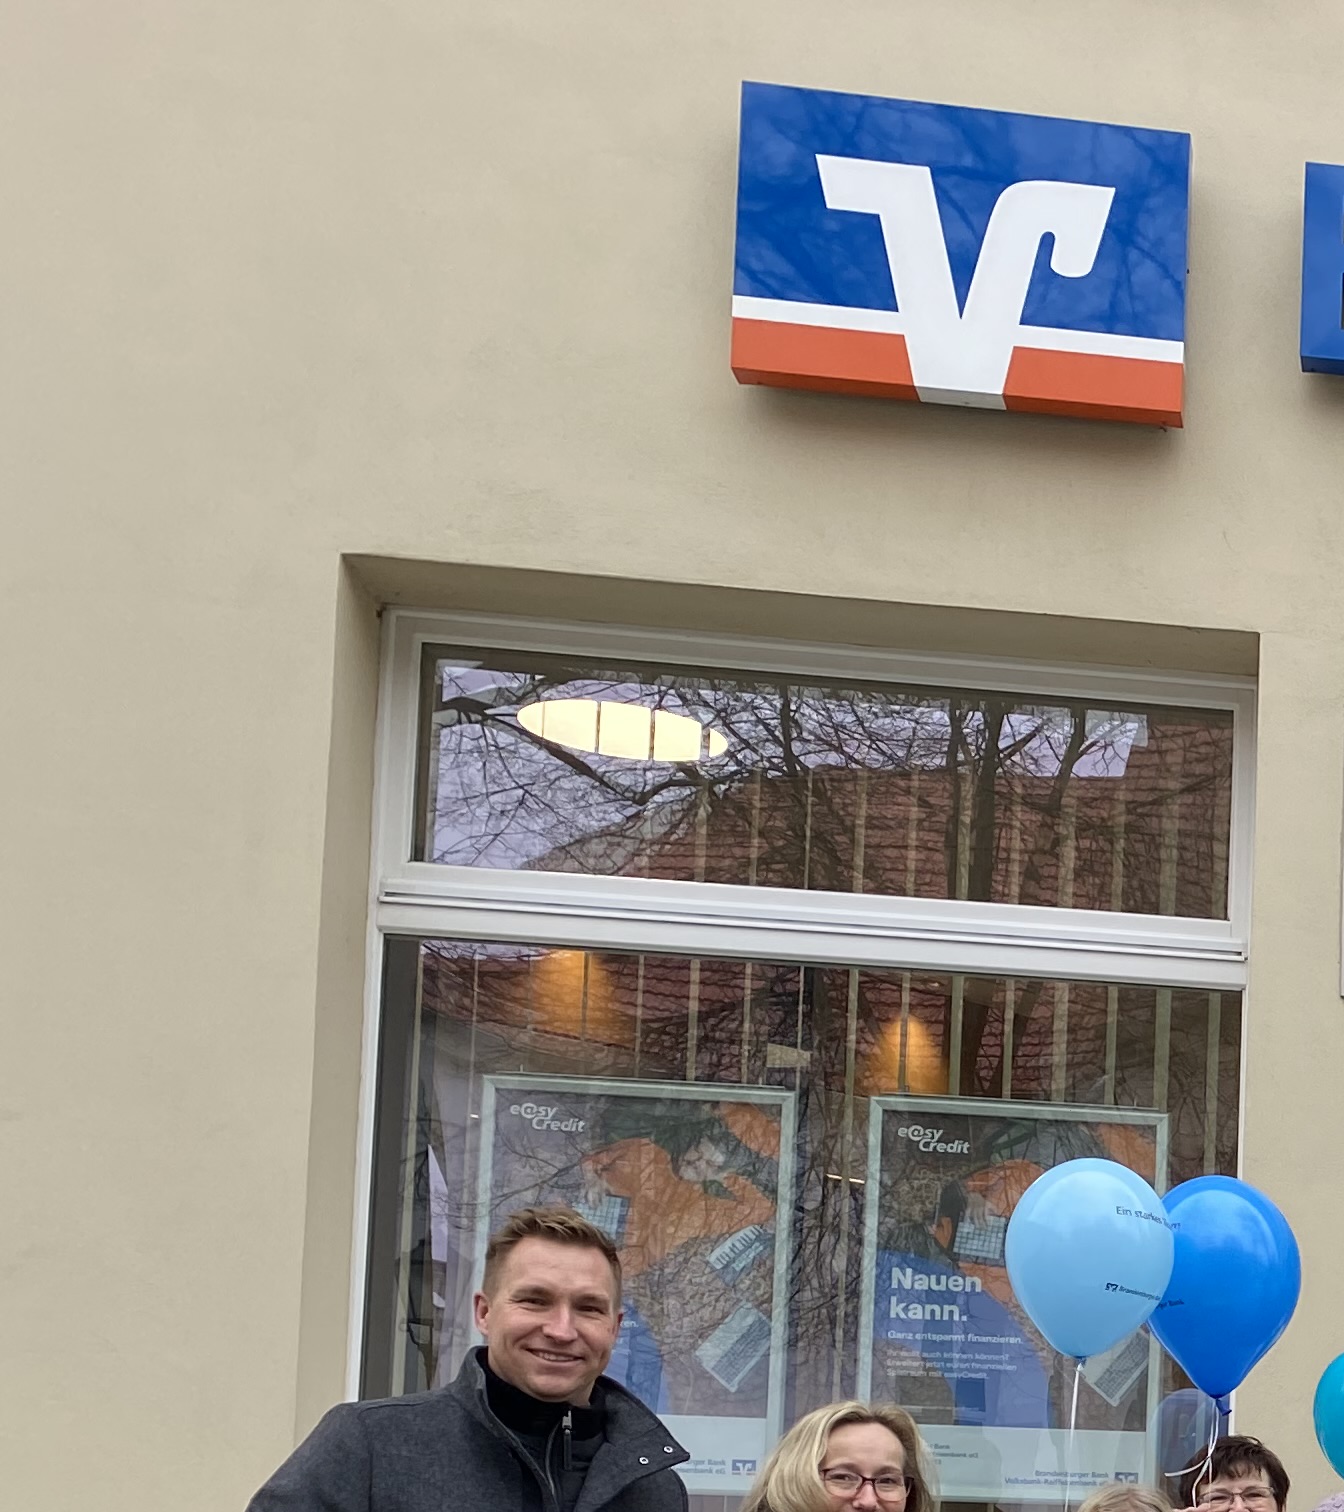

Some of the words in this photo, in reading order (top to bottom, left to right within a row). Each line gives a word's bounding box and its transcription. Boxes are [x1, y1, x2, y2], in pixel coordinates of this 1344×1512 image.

[531, 1115, 585, 1132] Credit
[918, 1137, 971, 1154] Credit
[1116, 1205, 1132, 1217] Ein
[890, 1266, 983, 1293] Nauen
[889, 1296, 968, 1322] kann.
